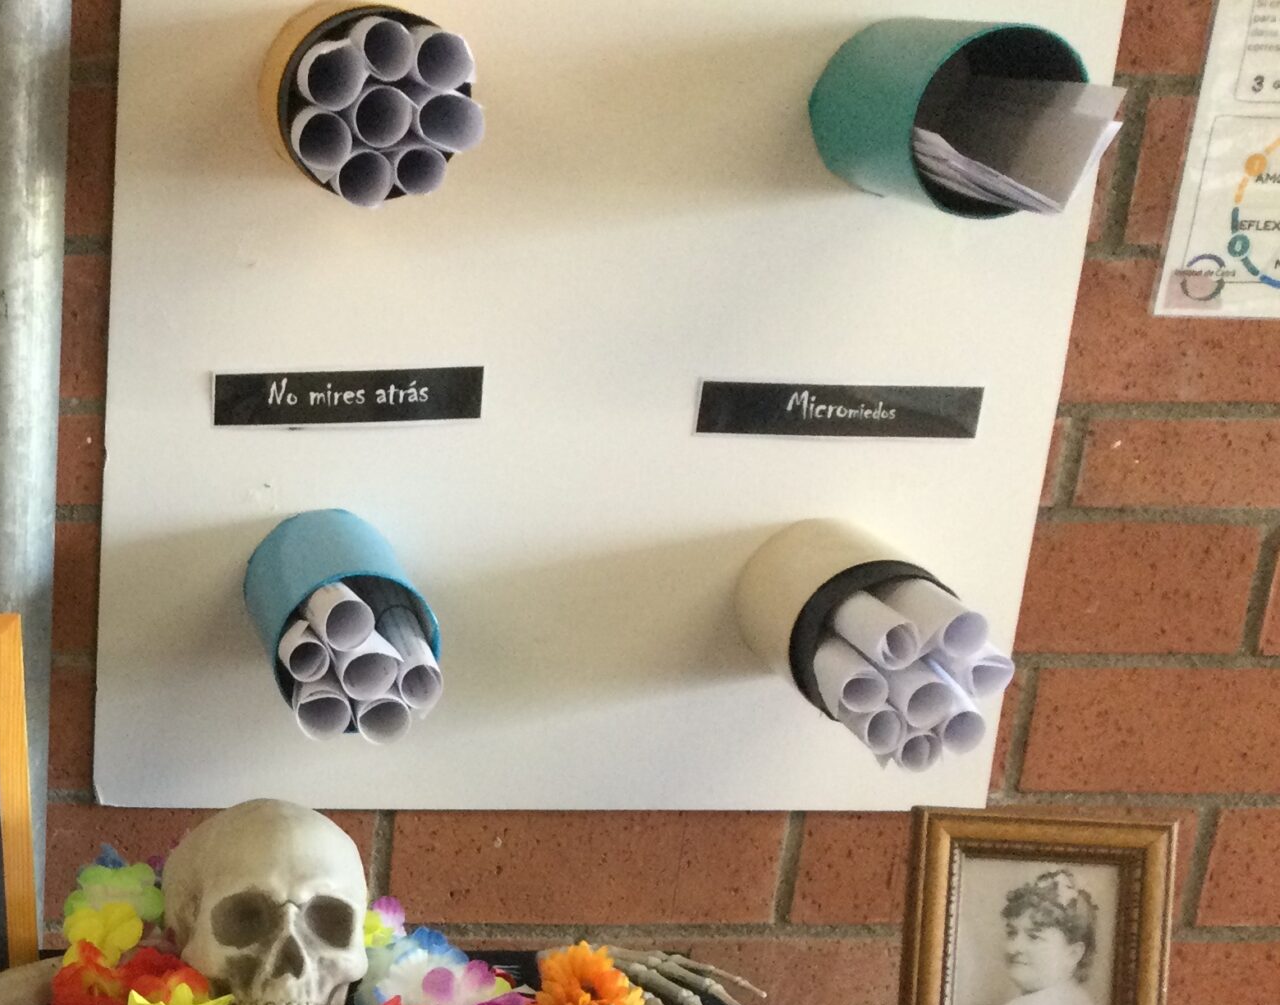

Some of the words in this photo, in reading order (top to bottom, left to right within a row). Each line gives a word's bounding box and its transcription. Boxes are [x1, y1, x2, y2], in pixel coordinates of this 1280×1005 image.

[1251, 75, 1265, 93] 3
[1233, 219, 1280, 231] EFLEX
[268, 377, 298, 405] No
[309, 382, 366, 407] mires
[375, 380, 429, 405] atrás
[786, 390, 896, 420] Micromiedos
